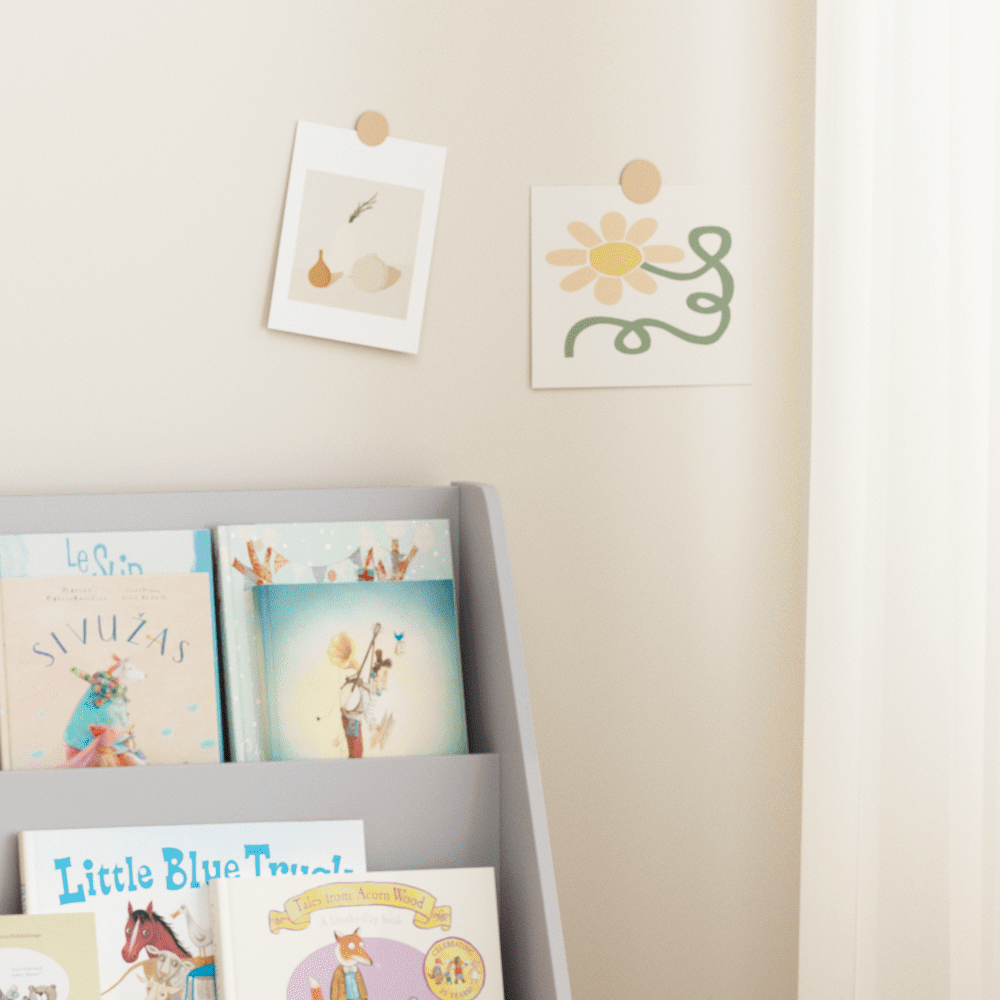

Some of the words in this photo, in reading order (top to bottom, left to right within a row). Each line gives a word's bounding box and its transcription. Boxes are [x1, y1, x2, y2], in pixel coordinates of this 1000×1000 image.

[66, 538, 88, 573] Le
[33, 612, 190, 668] SIVUŽAS
[54, 856, 154, 905] Little
[162, 847, 241, 890] Blue
[293, 897, 322, 912] Tales
[325, 893, 352, 905] from
[357, 886, 391, 902] Acorn
[393, 887, 426, 909] Wood
